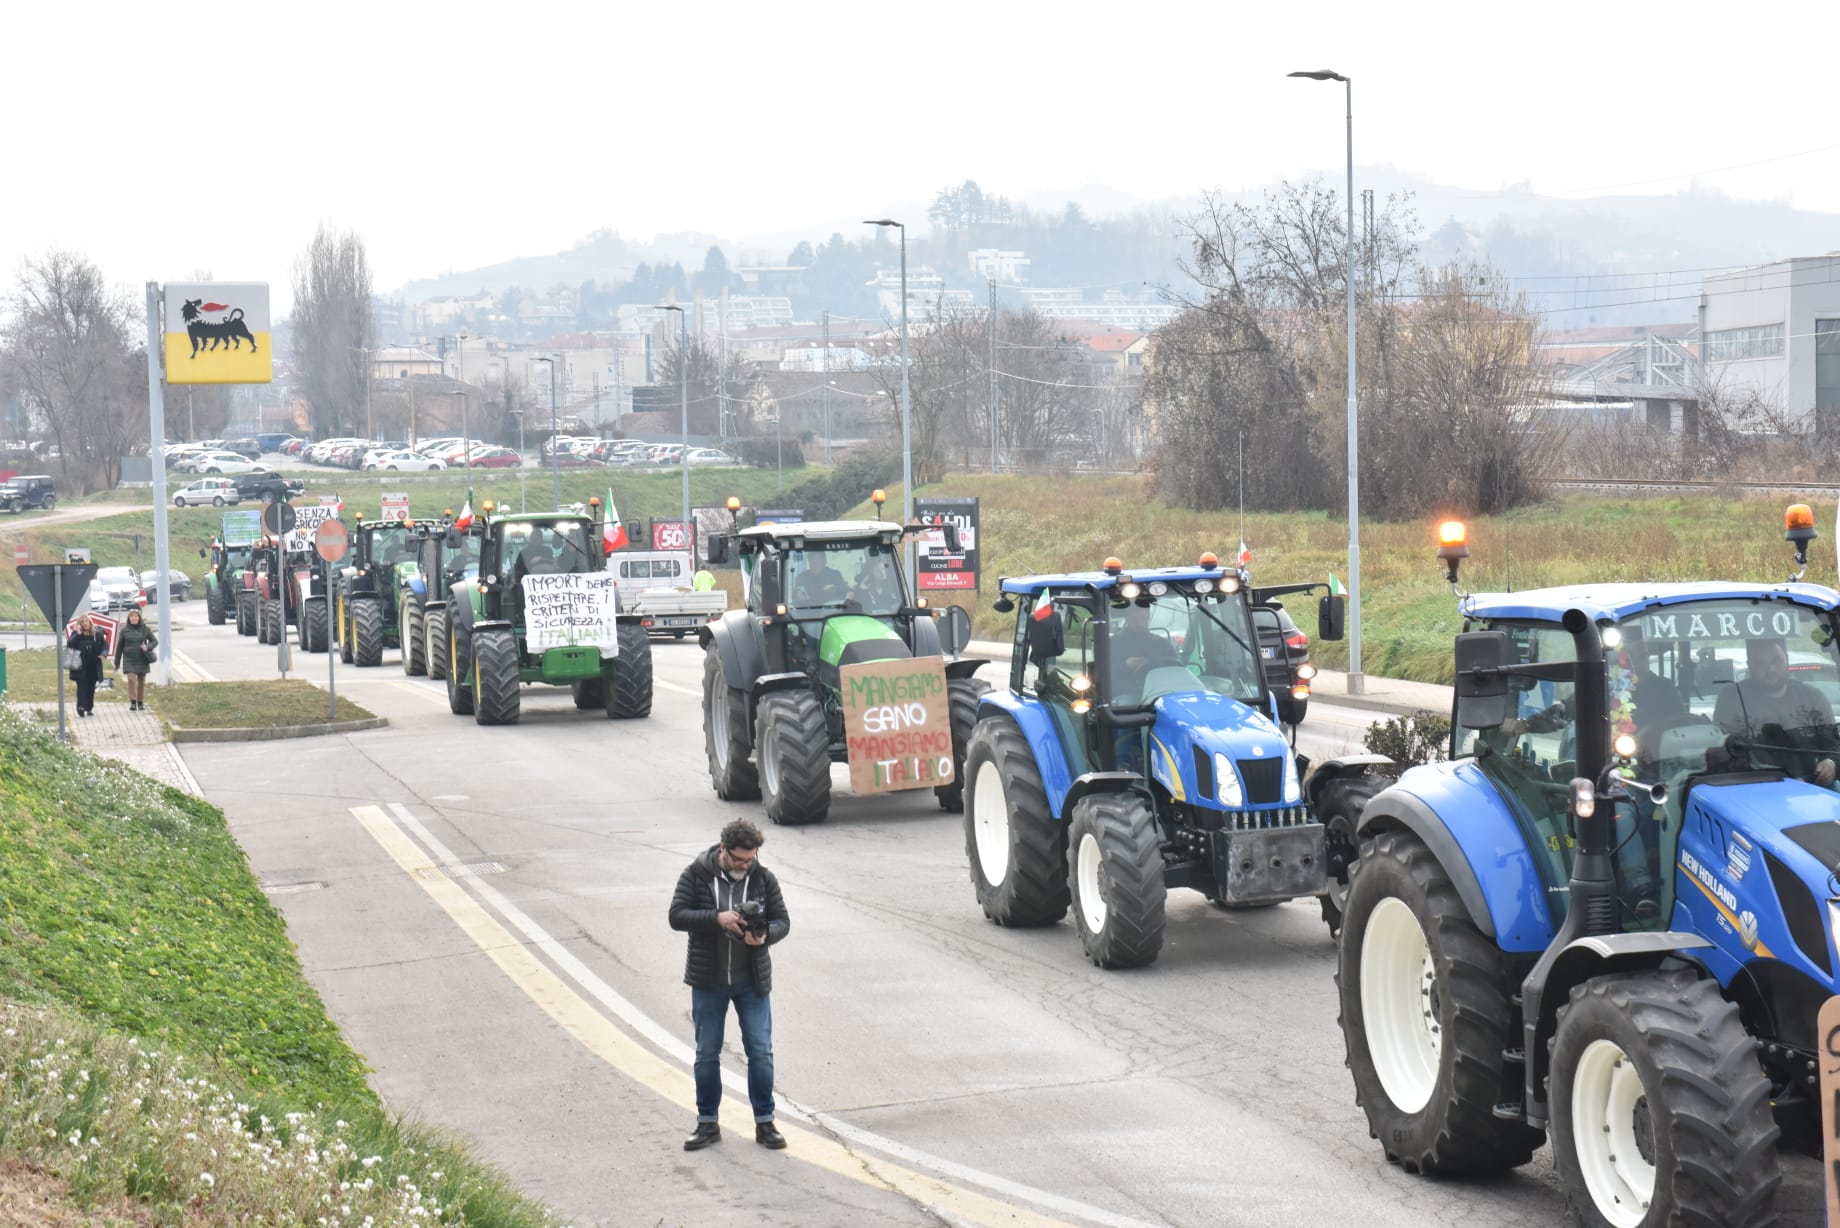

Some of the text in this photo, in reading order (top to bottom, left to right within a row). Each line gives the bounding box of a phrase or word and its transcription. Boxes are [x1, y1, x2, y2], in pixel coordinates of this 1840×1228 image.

[296, 508, 334, 519] SENZA
[291, 540, 304, 550] NO
[527, 574, 613, 592] IMPORT DEVE
[934, 573, 959, 581] ALBA
[587, 605, 599, 615] DI
[539, 618, 612, 645] ITALIANI
[1653, 611, 1792, 638] MARCO
[849, 672, 943, 709] MANGIAMO
[863, 702, 927, 733] SANO
[848, 731, 949, 761] MANGIAMO
[873, 755, 953, 787] ITALIANO
[1682, 849, 1699, 875] NEW
[1699, 864, 1737, 912] HOLLAND
